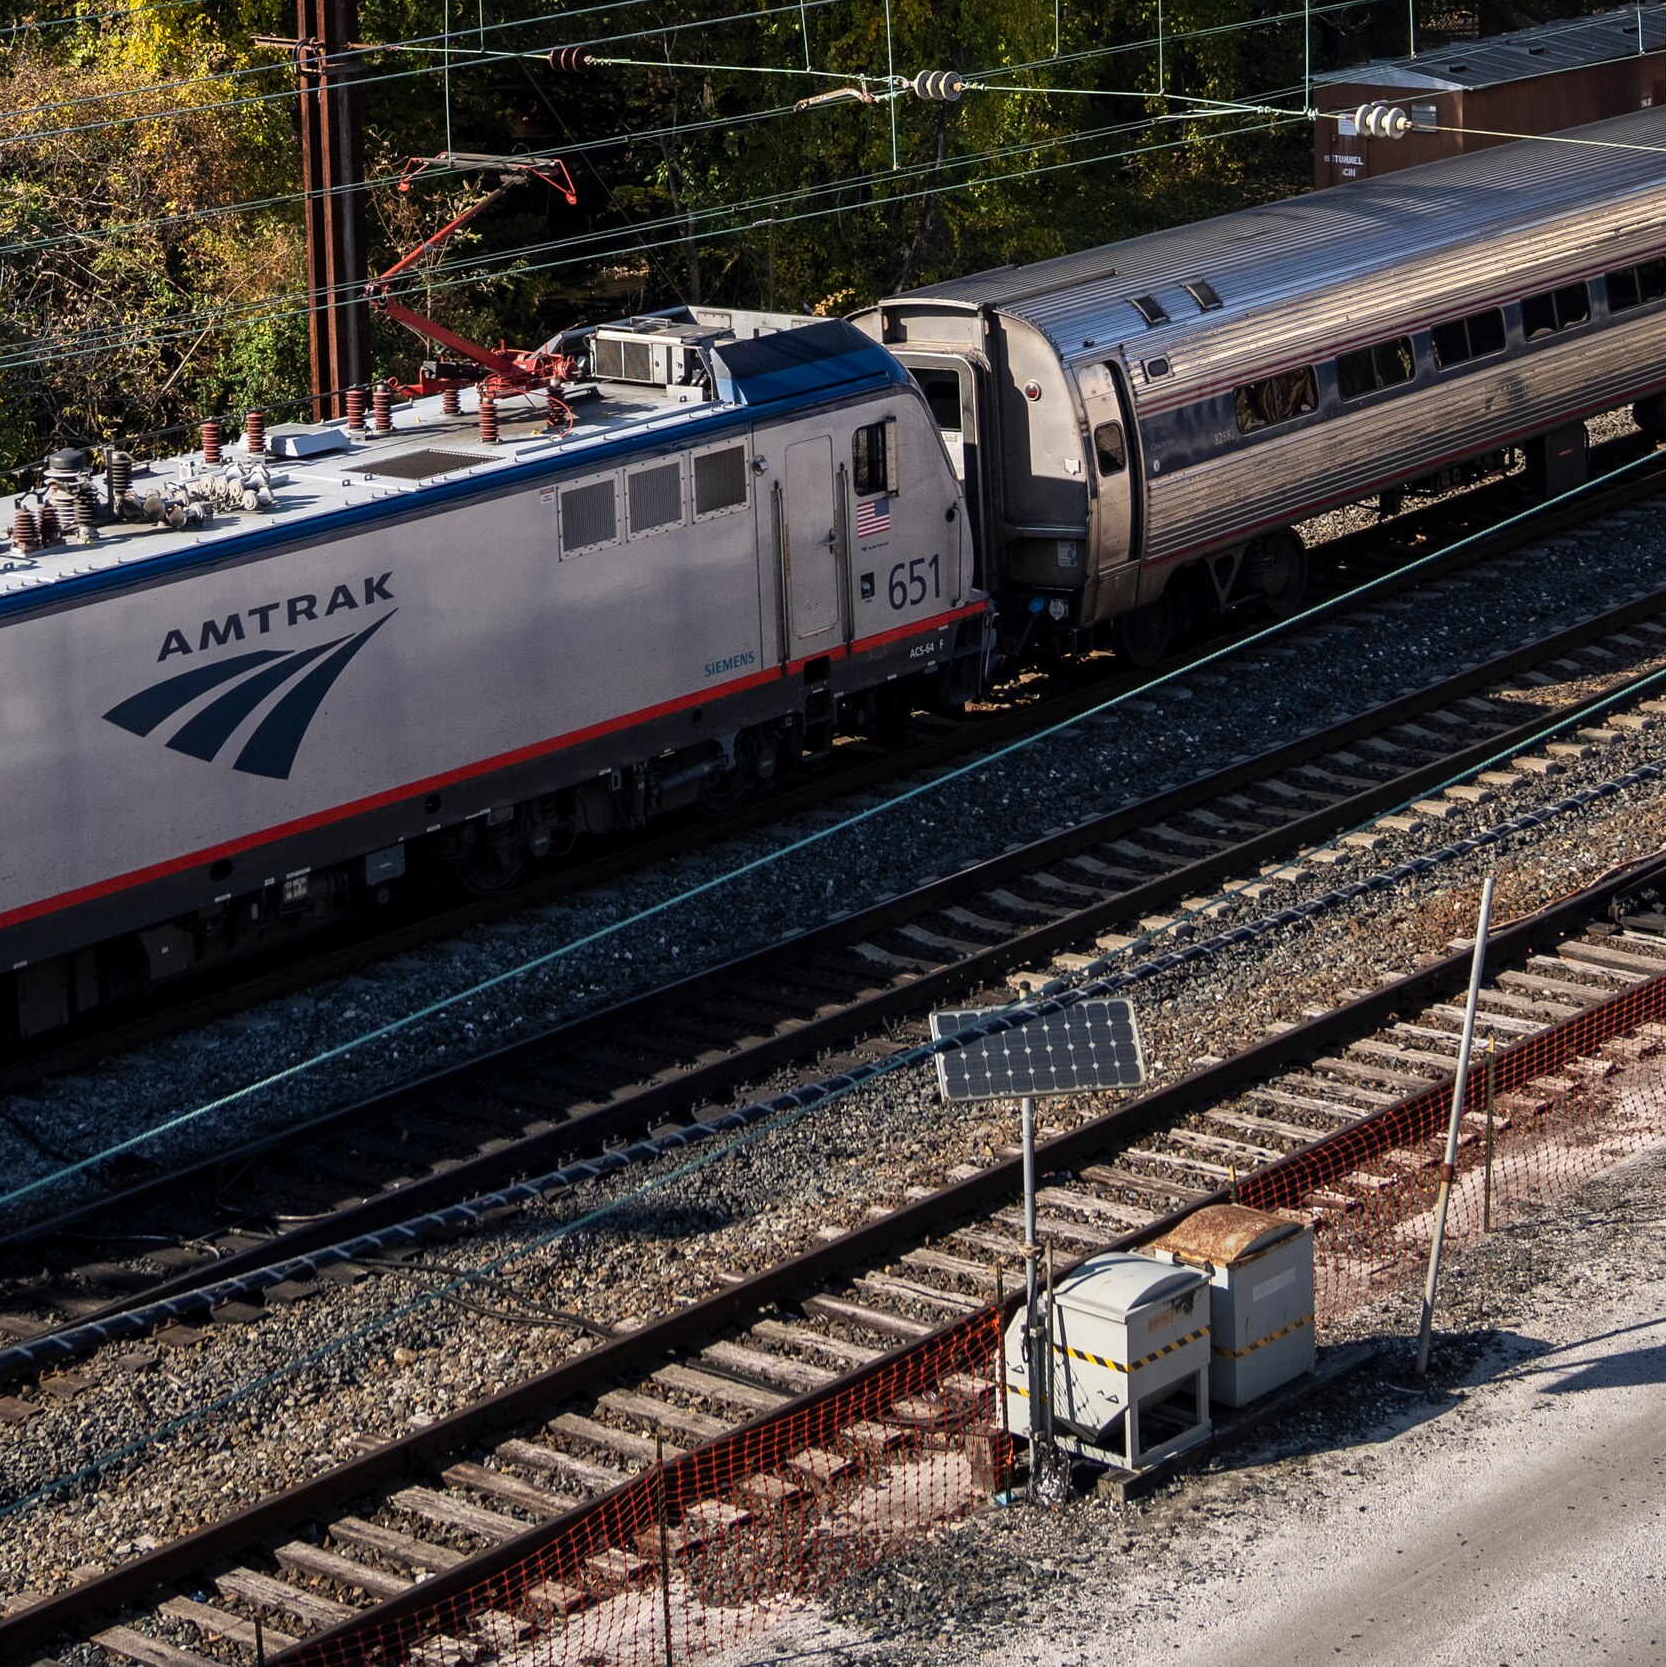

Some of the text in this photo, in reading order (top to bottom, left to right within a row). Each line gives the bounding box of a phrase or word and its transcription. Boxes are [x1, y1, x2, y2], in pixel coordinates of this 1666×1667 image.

[888, 553, 940, 611] 651
[156, 570, 396, 663] AMTRAK
[704, 650, 755, 678] SIEMENS
[909, 642, 935, 659] ACS-64
